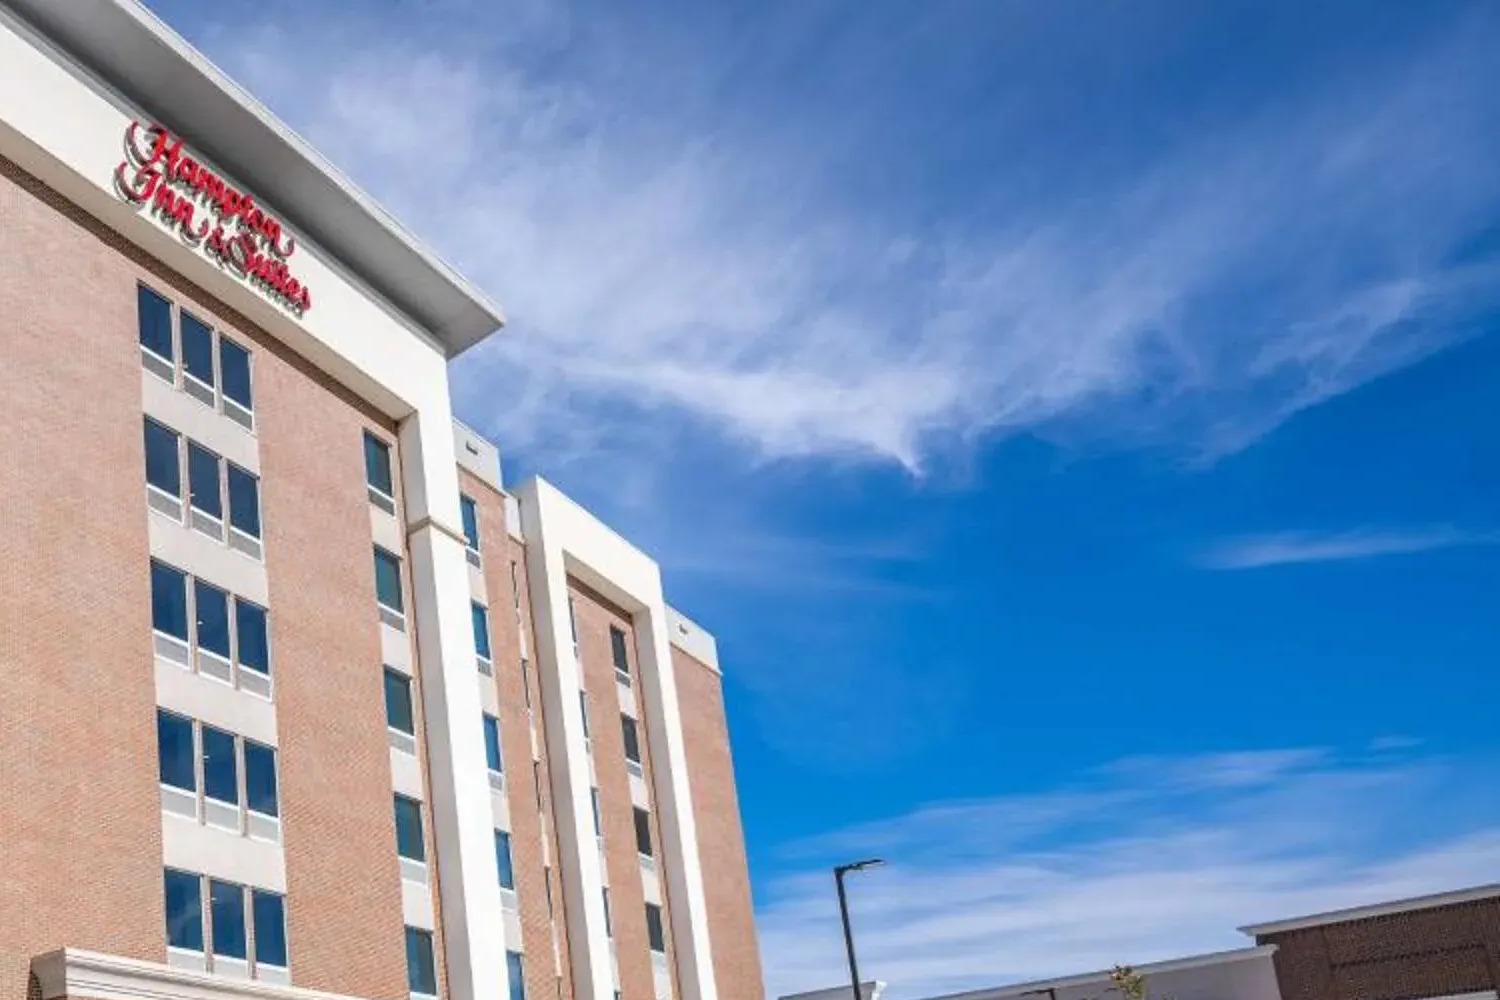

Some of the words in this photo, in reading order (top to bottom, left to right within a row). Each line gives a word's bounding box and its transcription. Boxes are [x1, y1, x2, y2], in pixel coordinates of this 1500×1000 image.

[116, 160, 209, 239] Inn
[226, 232, 311, 311] Suites
[124, 120, 295, 257] Hampton
